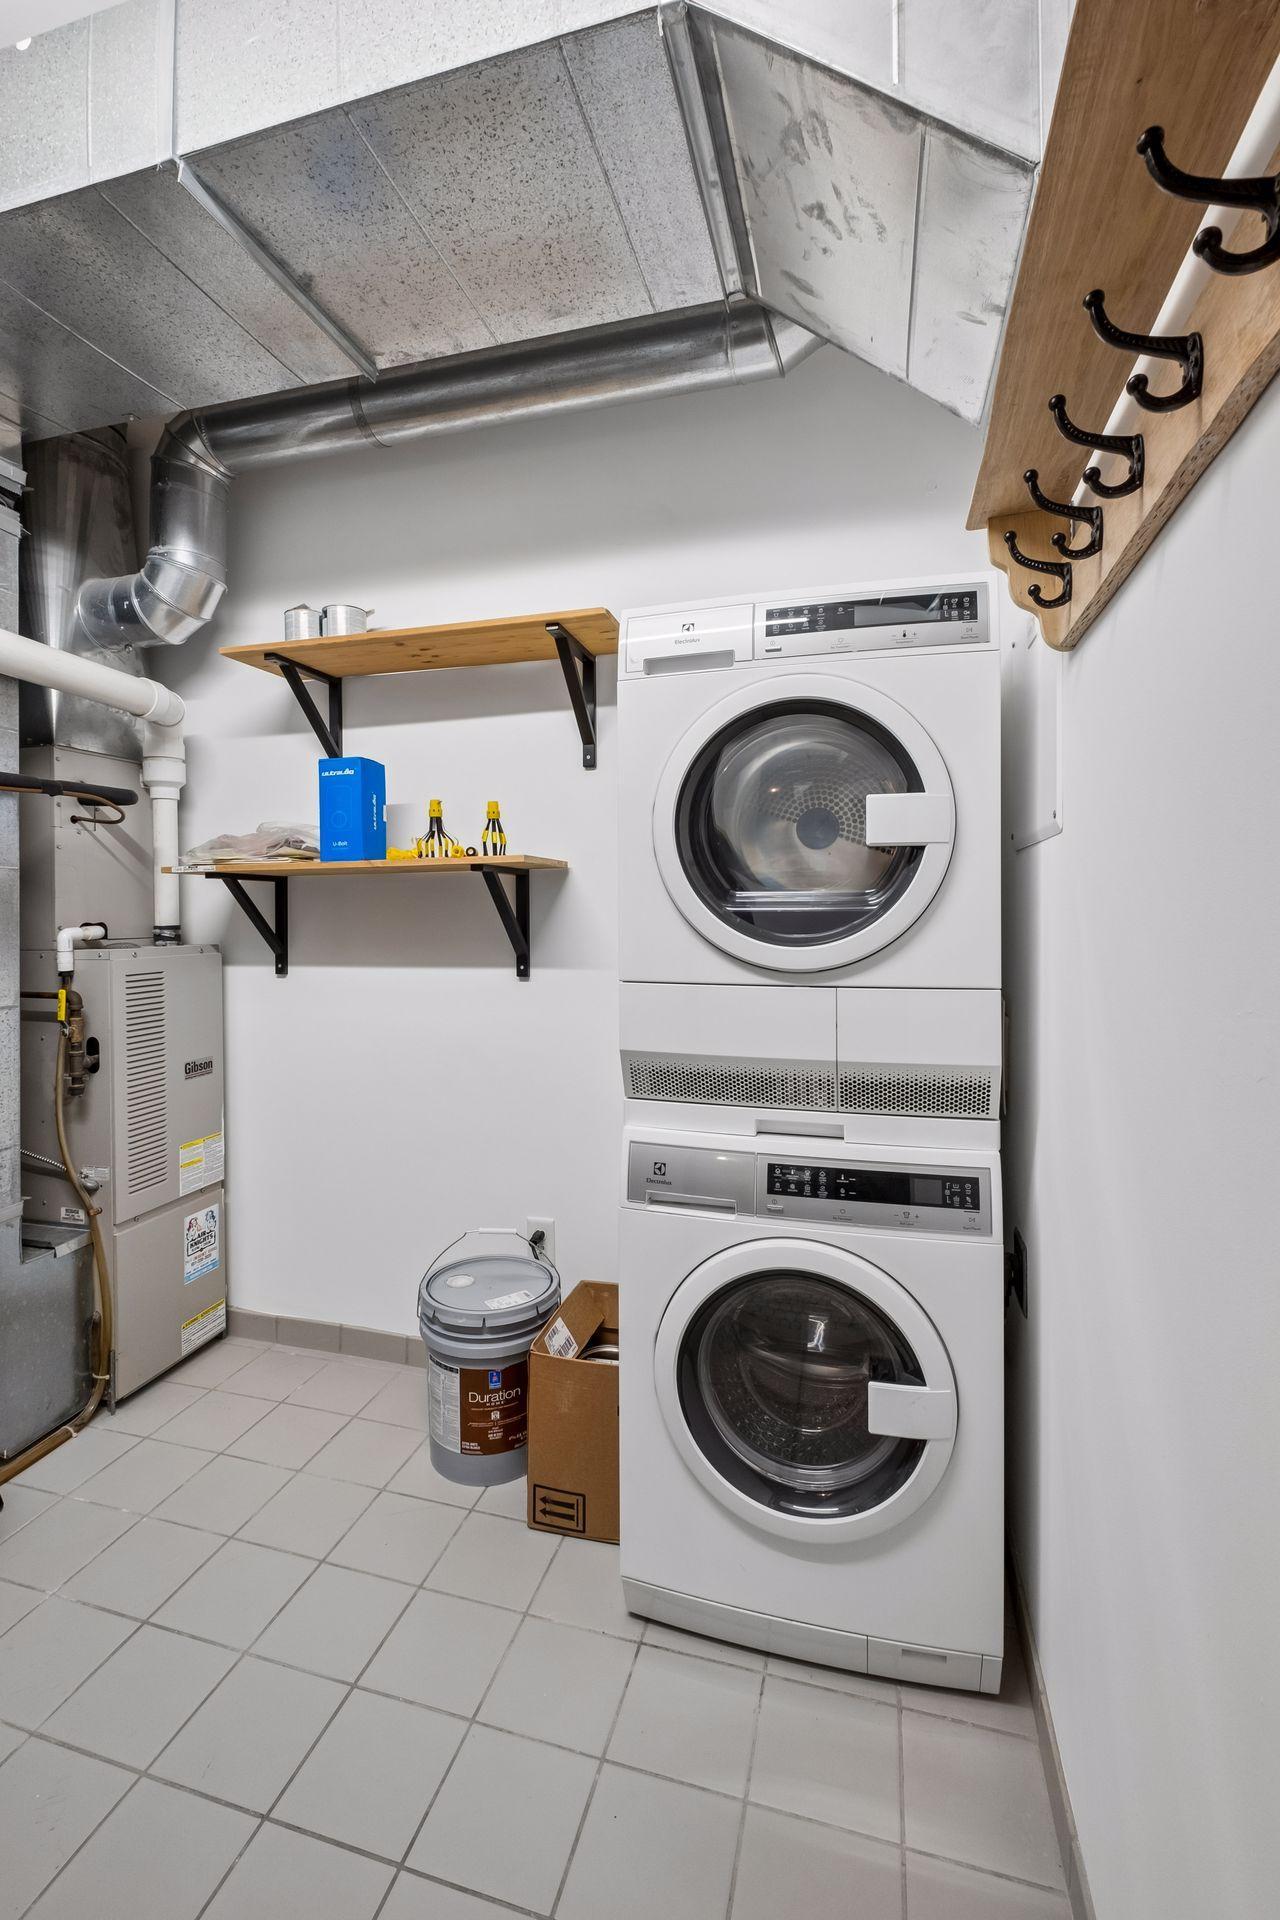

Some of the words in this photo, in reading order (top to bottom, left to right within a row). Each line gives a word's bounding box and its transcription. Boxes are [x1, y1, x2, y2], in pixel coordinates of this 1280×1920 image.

[184, 1060, 213, 1075] Gibson
[646, 1177, 673, 1186] Electrolux
[189, 1233, 214, 1249] KNIGHTS
[468, 1387, 521, 1403] Duration
